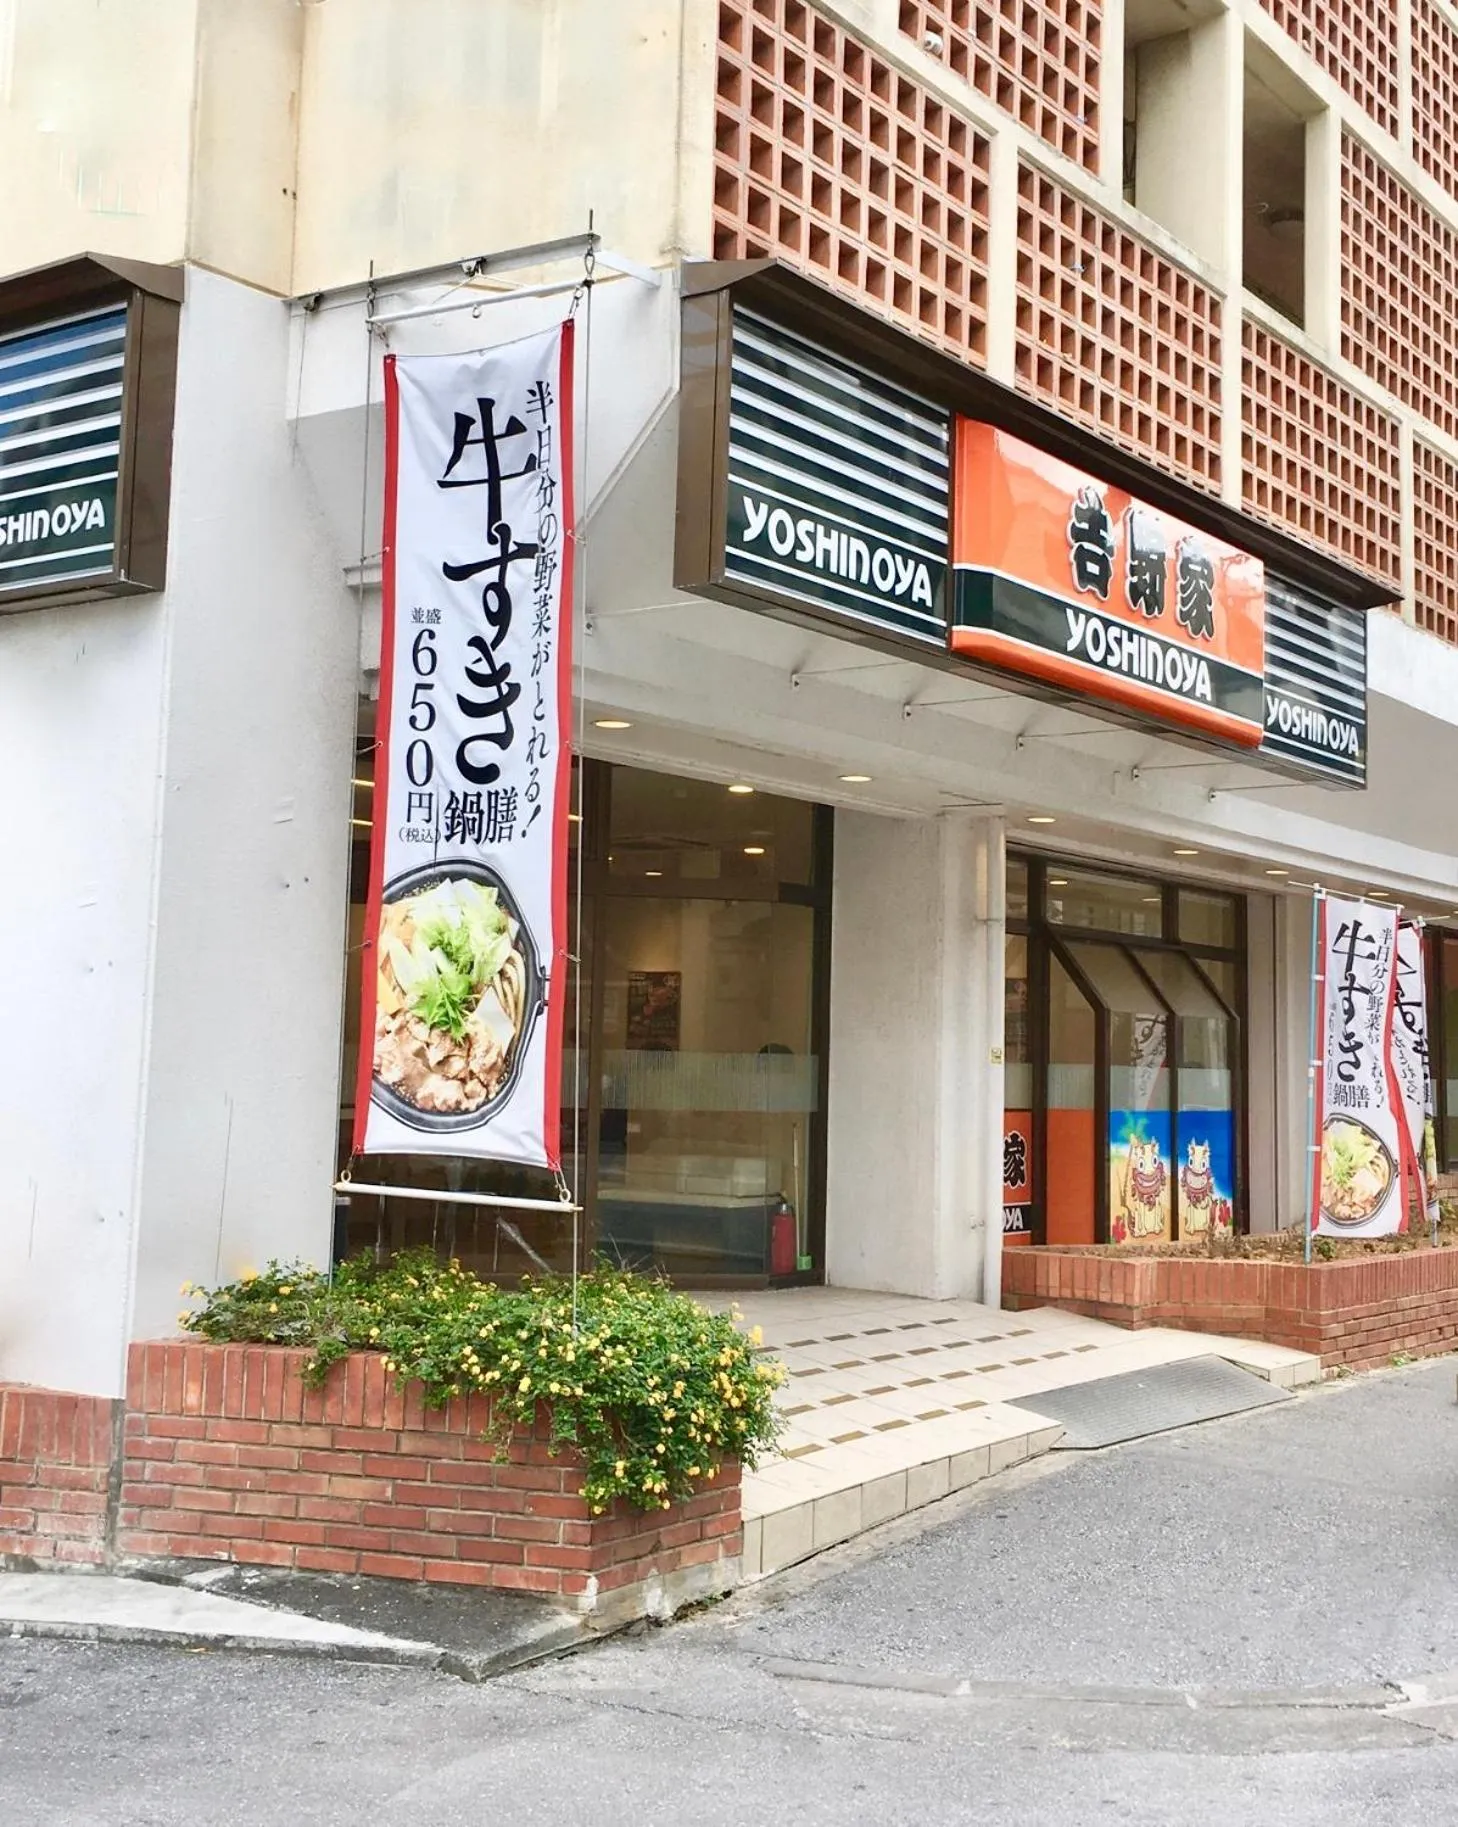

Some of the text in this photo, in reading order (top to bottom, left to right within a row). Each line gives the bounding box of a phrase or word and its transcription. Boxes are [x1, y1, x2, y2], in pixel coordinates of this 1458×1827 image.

[742, 496, 933, 607] YOSHINOYA
[411, 607, 442, 625] 並盛
[1065, 608, 1212, 700] YOSHINOYA
[1266, 694, 1360, 757] YOSHINOYA
[444, 786, 519, 844] 鍋膳
